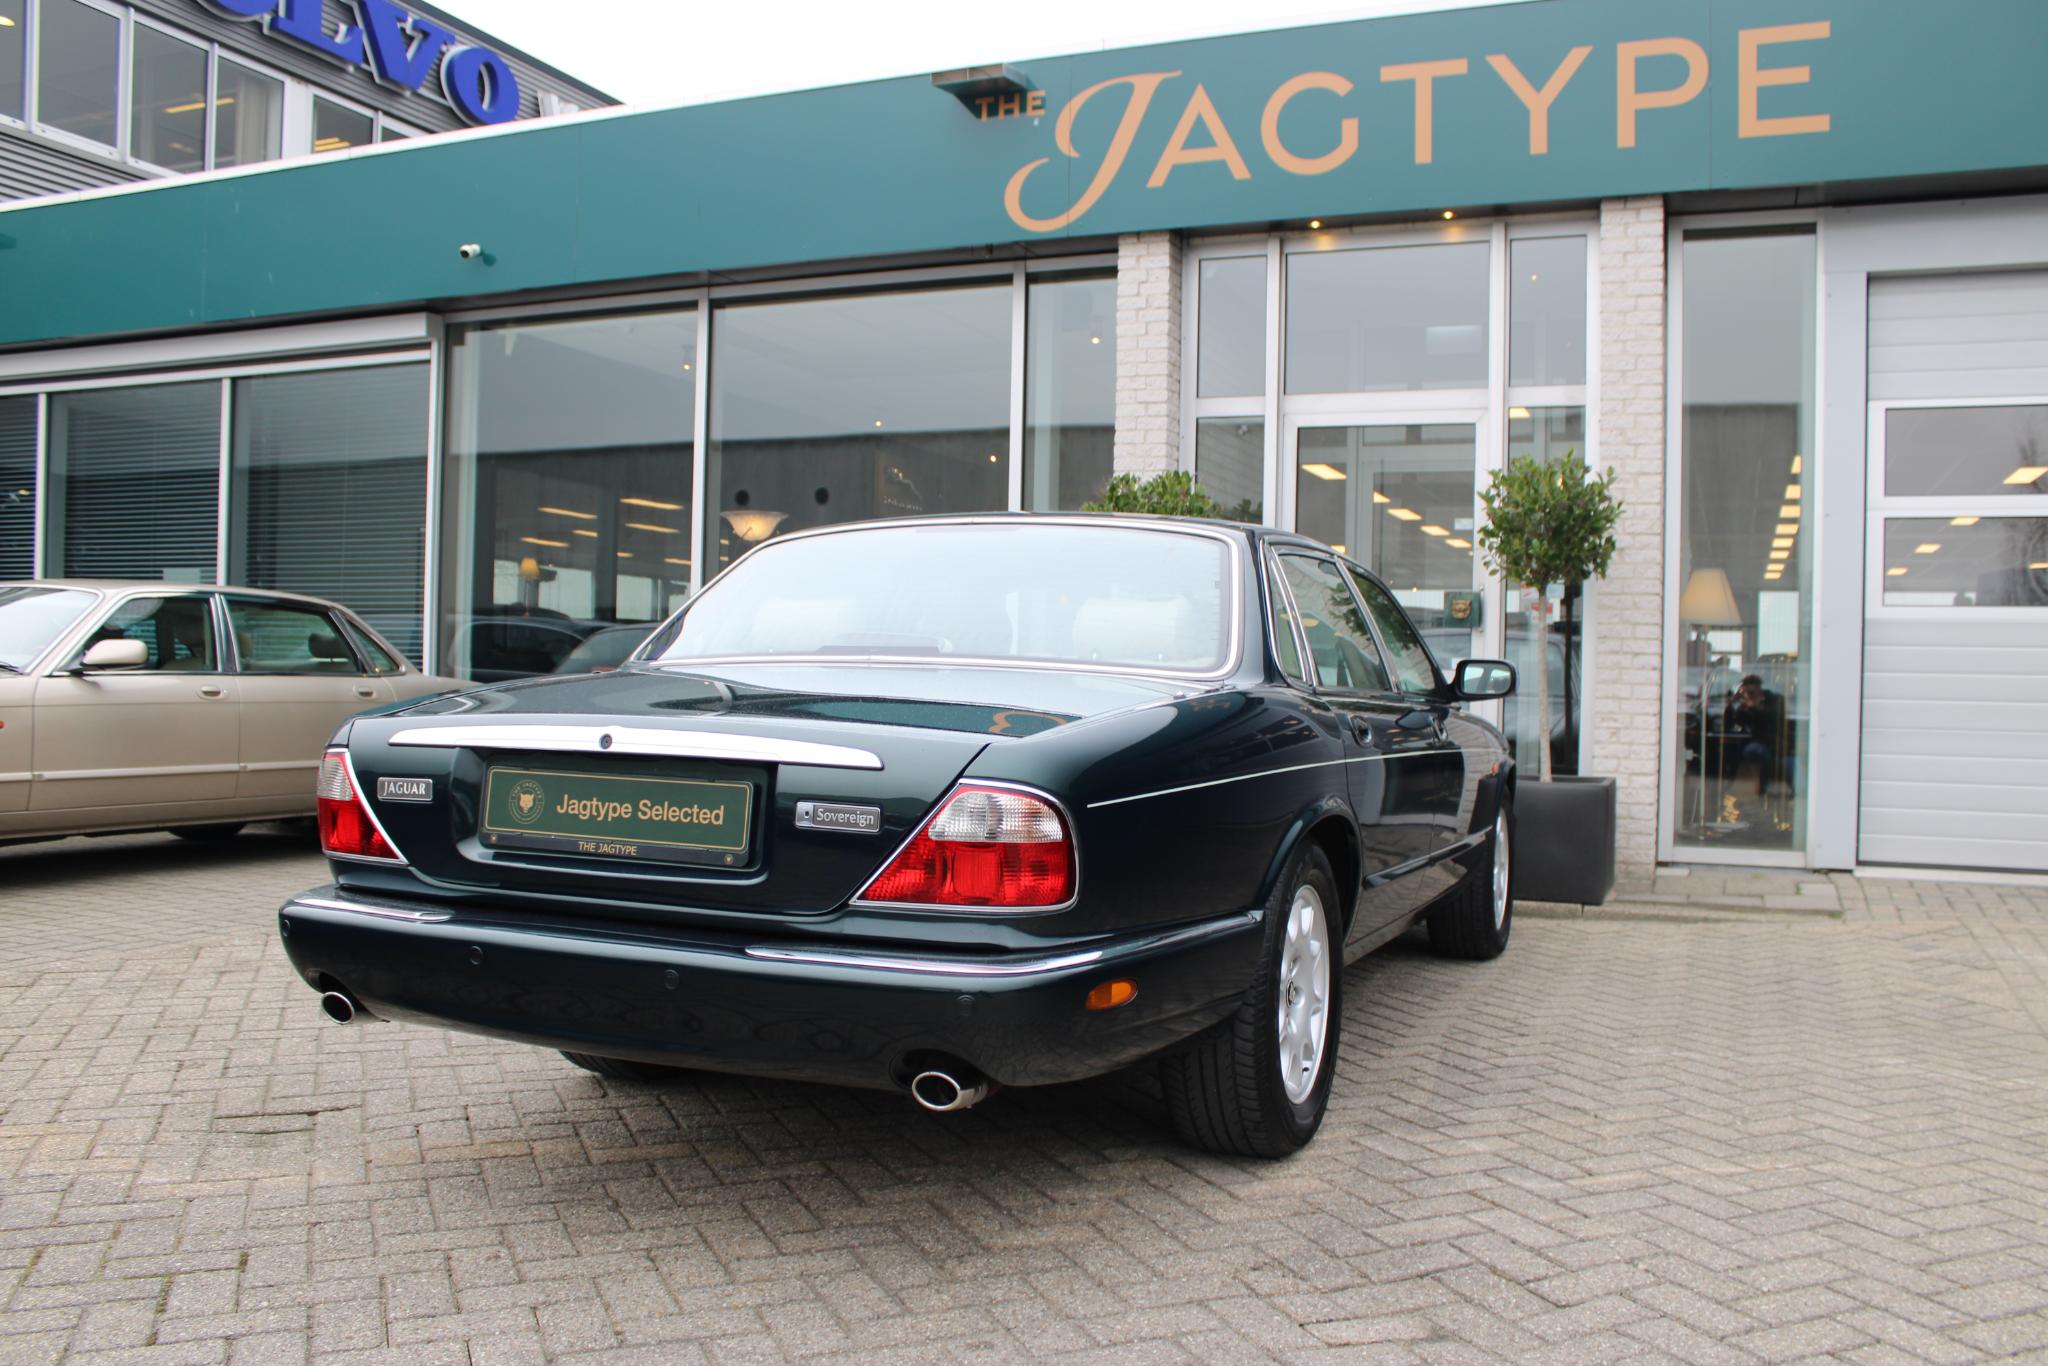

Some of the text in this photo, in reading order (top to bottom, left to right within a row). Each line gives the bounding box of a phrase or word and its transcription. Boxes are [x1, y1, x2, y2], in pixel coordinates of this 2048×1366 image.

[975, 20, 1832, 233] THE JAGTYPE
[383, 781, 426, 796] JAGUAR
[556, 794, 632, 821] Jagtype
[637, 799, 724, 825] Selected
[816, 808, 875, 827] Sovereign
[578, 841, 638, 856] THE JAGTYPE
